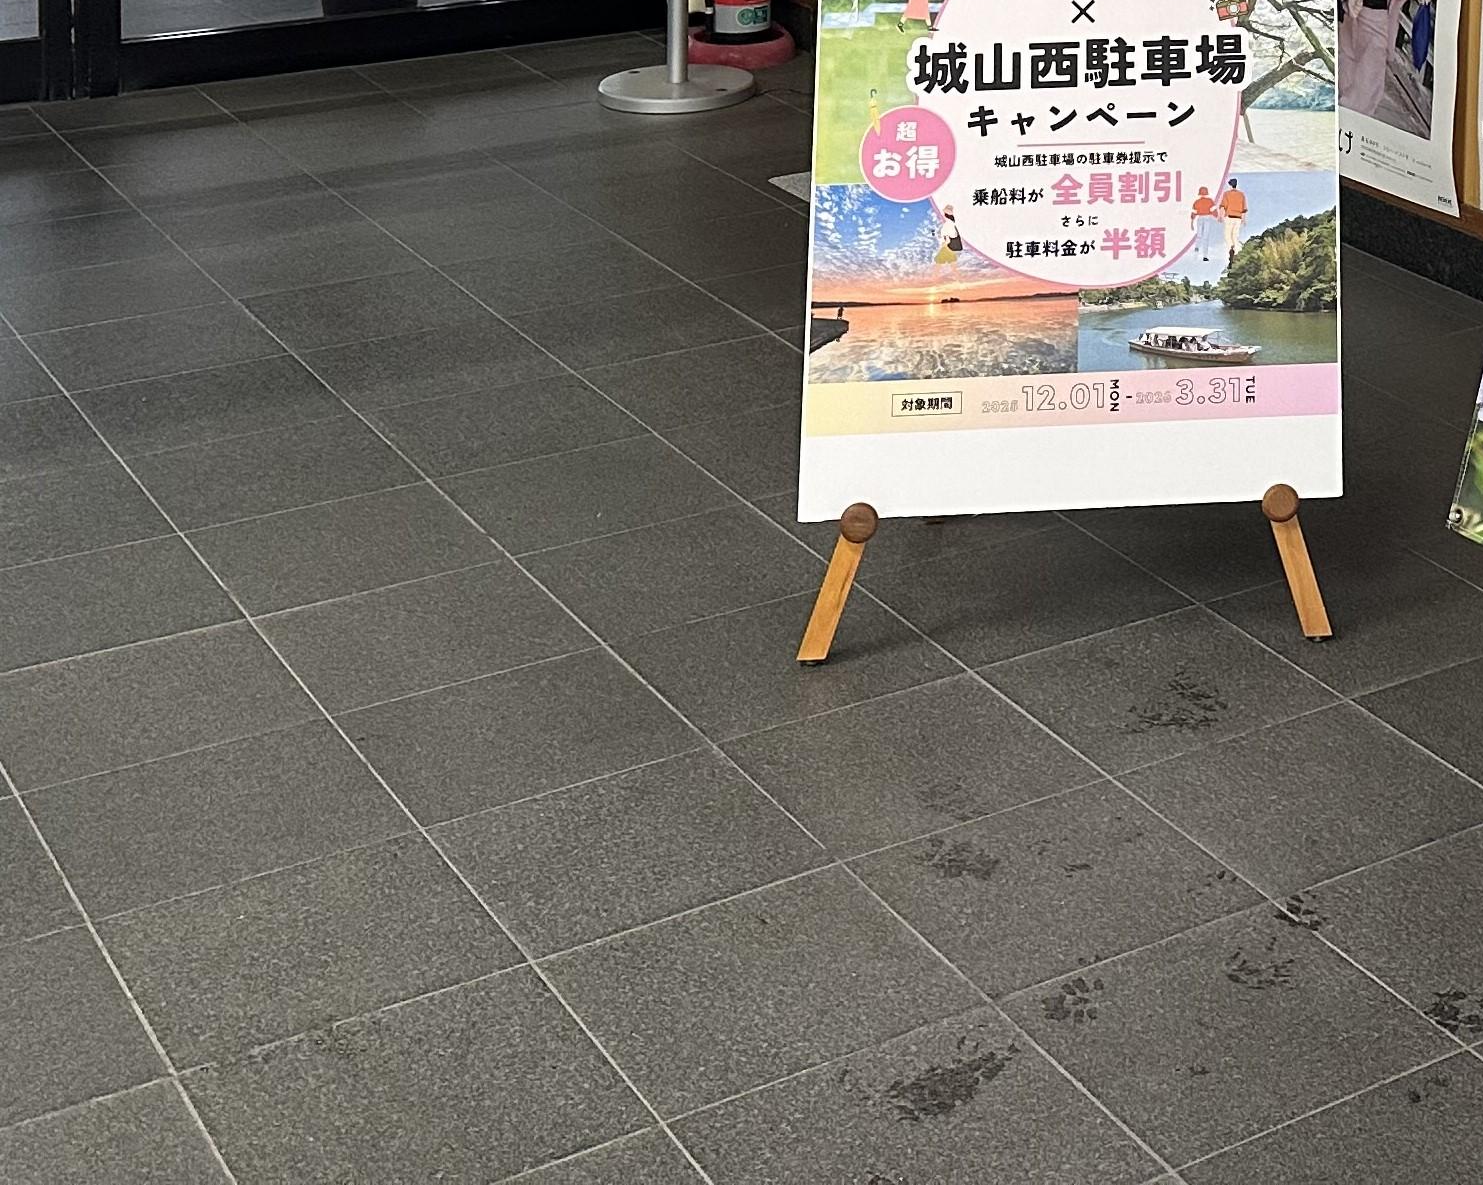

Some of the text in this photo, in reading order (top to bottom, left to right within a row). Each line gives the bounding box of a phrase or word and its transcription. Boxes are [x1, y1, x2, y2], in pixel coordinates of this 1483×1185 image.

[914, 34, 1248, 94] 城山西駐車場
[896, 121, 917, 143] 超
[967, 101, 1196, 137] キャンペーン
[872, 146, 941, 180] お得
[994, 151, 1169, 168] 城山西駐車場の駐車券提示で
[972, 172, 1183, 207] 乗船料が 全員割引
[1060, 214, 1099, 227] さらに
[1006, 227, 1166, 261] 駐車料金が 半額
[901, 395, 954, 412] 対象期間
[1022, 382, 1105, 413] 12.01
[1109, 378, 1120, 413] MON
[1176, 376, 1242, 406] 3.31
[1245, 375, 1256, 405] TUE
